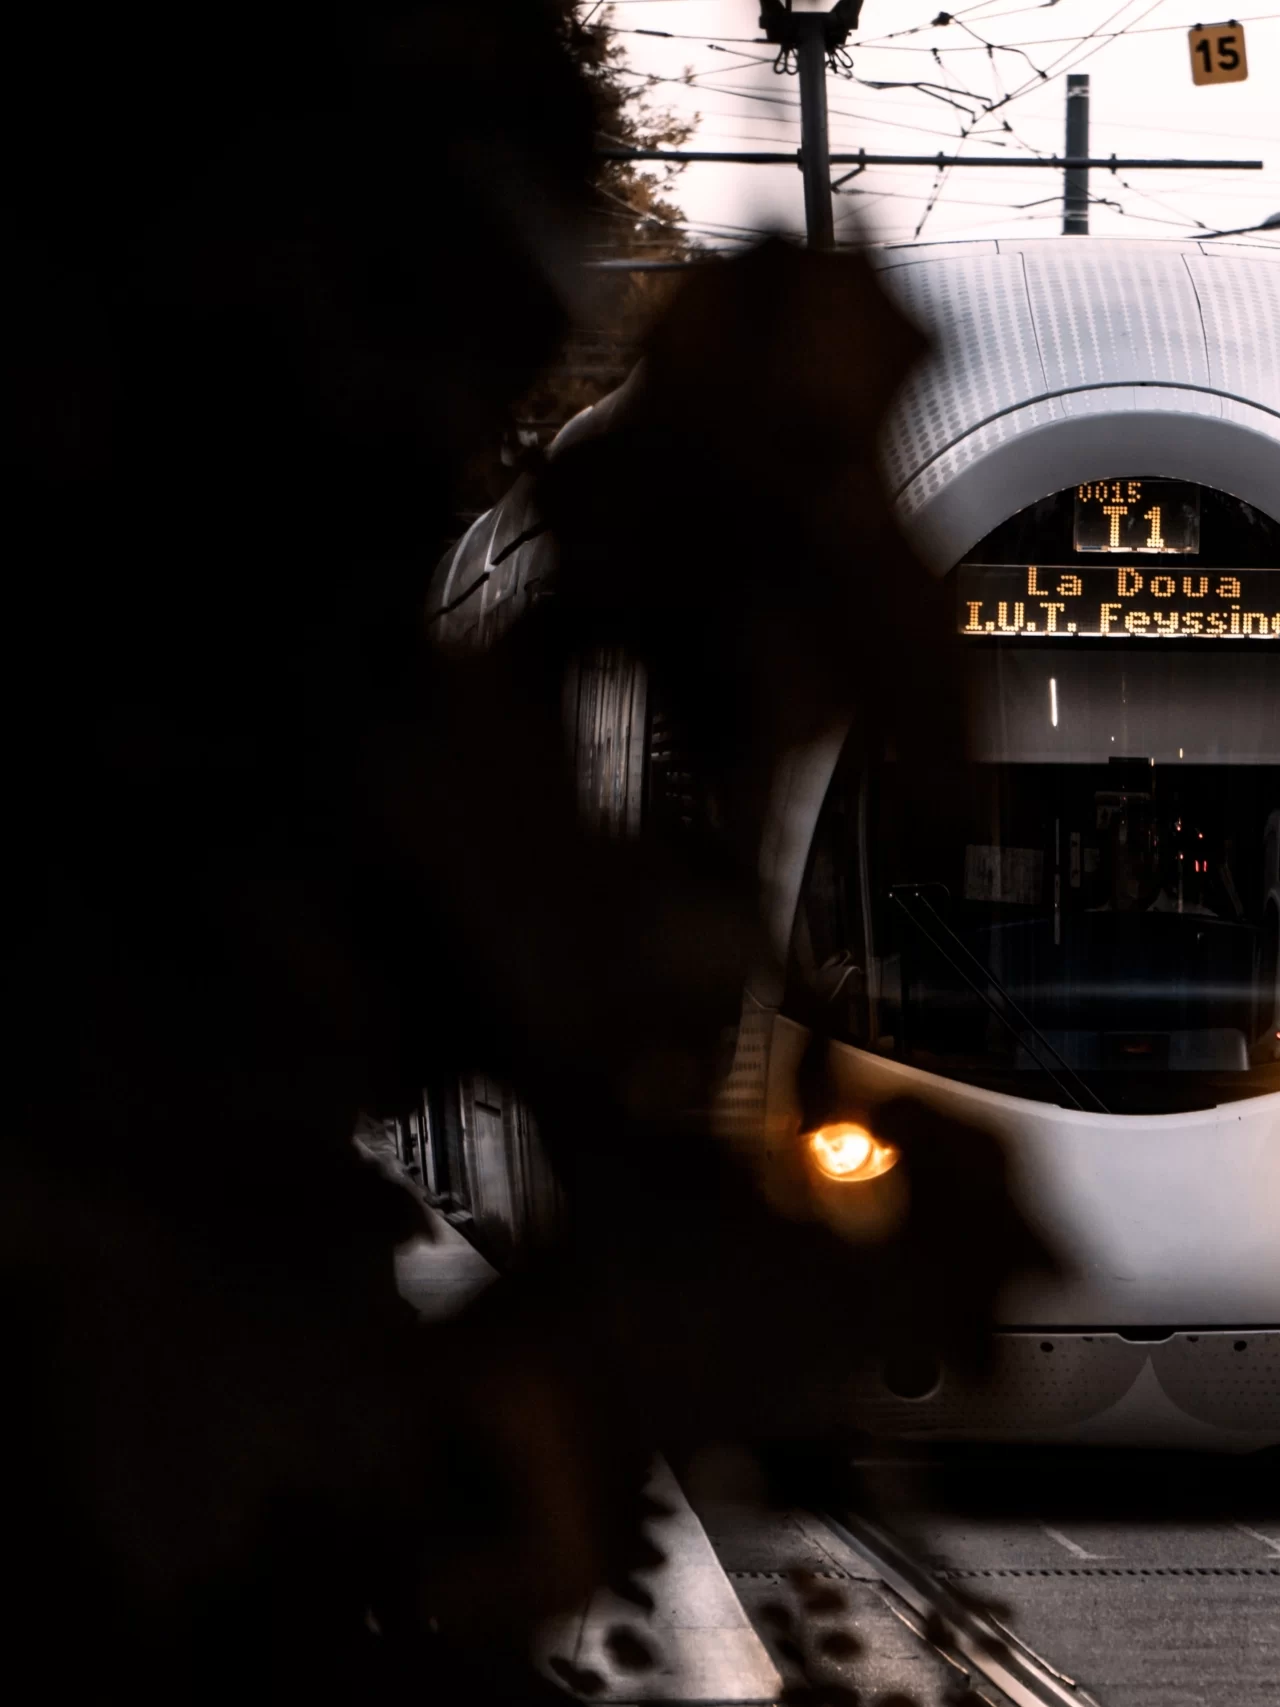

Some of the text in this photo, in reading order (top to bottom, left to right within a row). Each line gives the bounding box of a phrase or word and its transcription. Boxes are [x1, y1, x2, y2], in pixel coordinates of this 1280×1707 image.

[1195, 36, 1240, 73] 15
[1078, 481, 1142, 503] 0015
[1103, 506, 1164, 548] T1
[1028, 566, 1241, 598] La Doua
[965, 601, 1077, 633] I.U.T.
